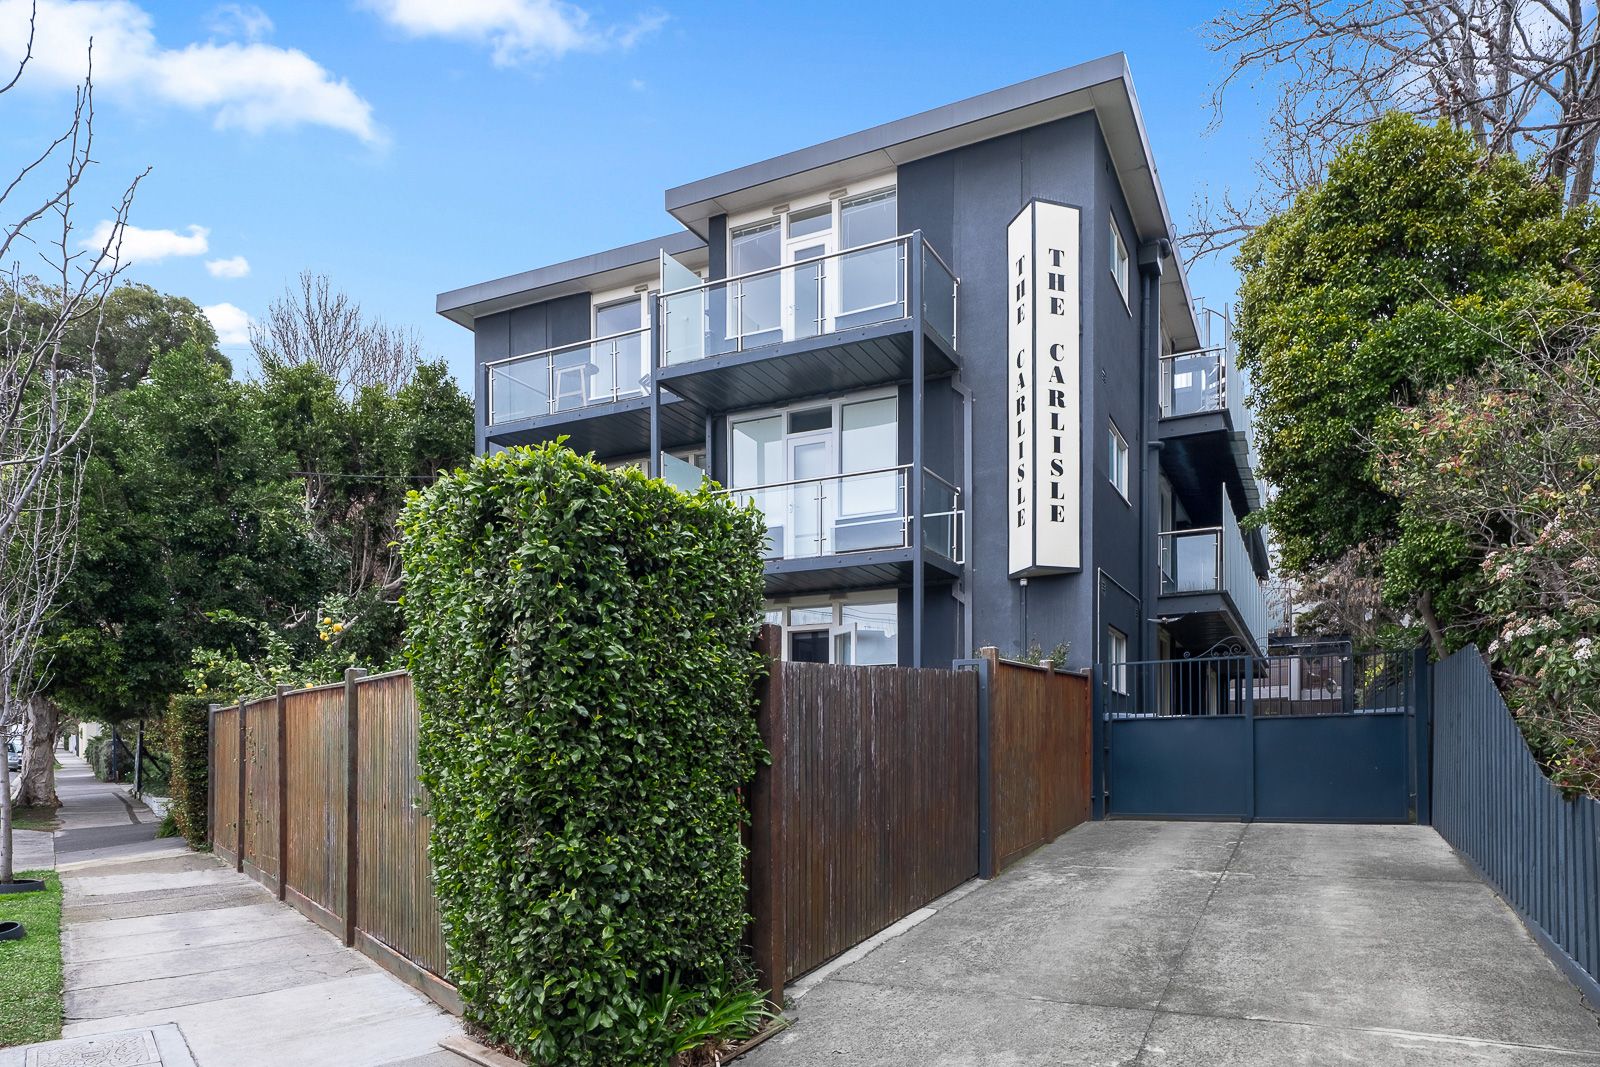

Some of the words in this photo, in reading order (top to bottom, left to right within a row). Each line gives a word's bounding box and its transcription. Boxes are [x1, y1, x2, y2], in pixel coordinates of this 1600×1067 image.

[1015, 254, 1026, 326] THE
[1048, 248, 1066, 316] THE
[1015, 348, 1026, 528] CARLISLE
[1048, 343, 1067, 523] CARLISLE
